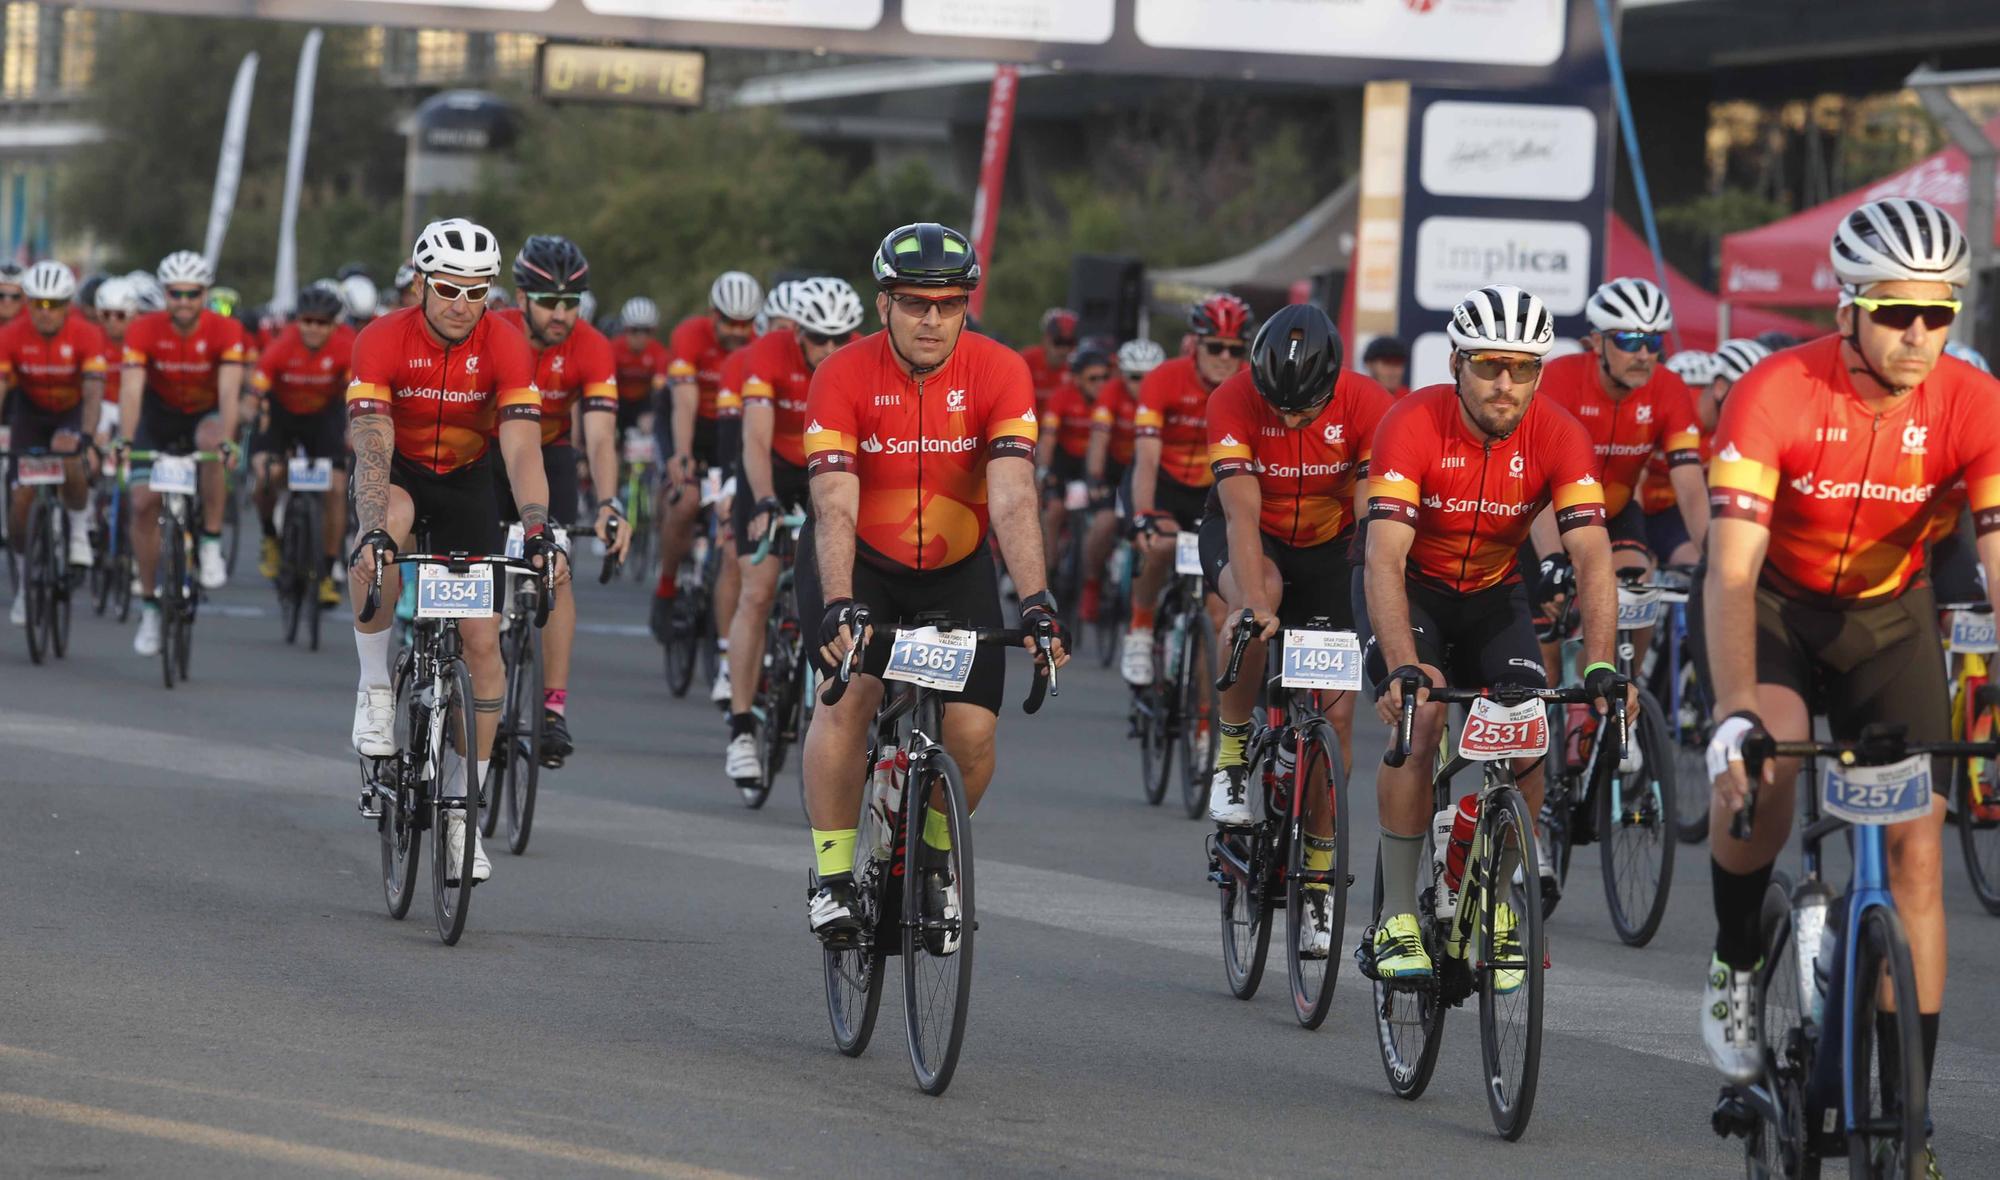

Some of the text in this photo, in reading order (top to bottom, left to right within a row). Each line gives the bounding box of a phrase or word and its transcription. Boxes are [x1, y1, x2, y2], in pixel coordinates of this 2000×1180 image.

[414, 386, 488, 403] Santander
[885, 436, 978, 455] Santander
[1268, 461, 1352, 478] Santande
[1815, 480, 1935, 503] Santander
[1443, 497, 1536, 517] Santander
[426, 581, 477, 601] 1354
[900, 643, 958, 672] 1365
[957, 651, 972, 679] 105 km
[1291, 649, 1345, 672] 1494
[1468, 719, 1529, 744] 2531
[1537, 719, 1545, 733] km
[1832, 780, 1908, 808] 1257
